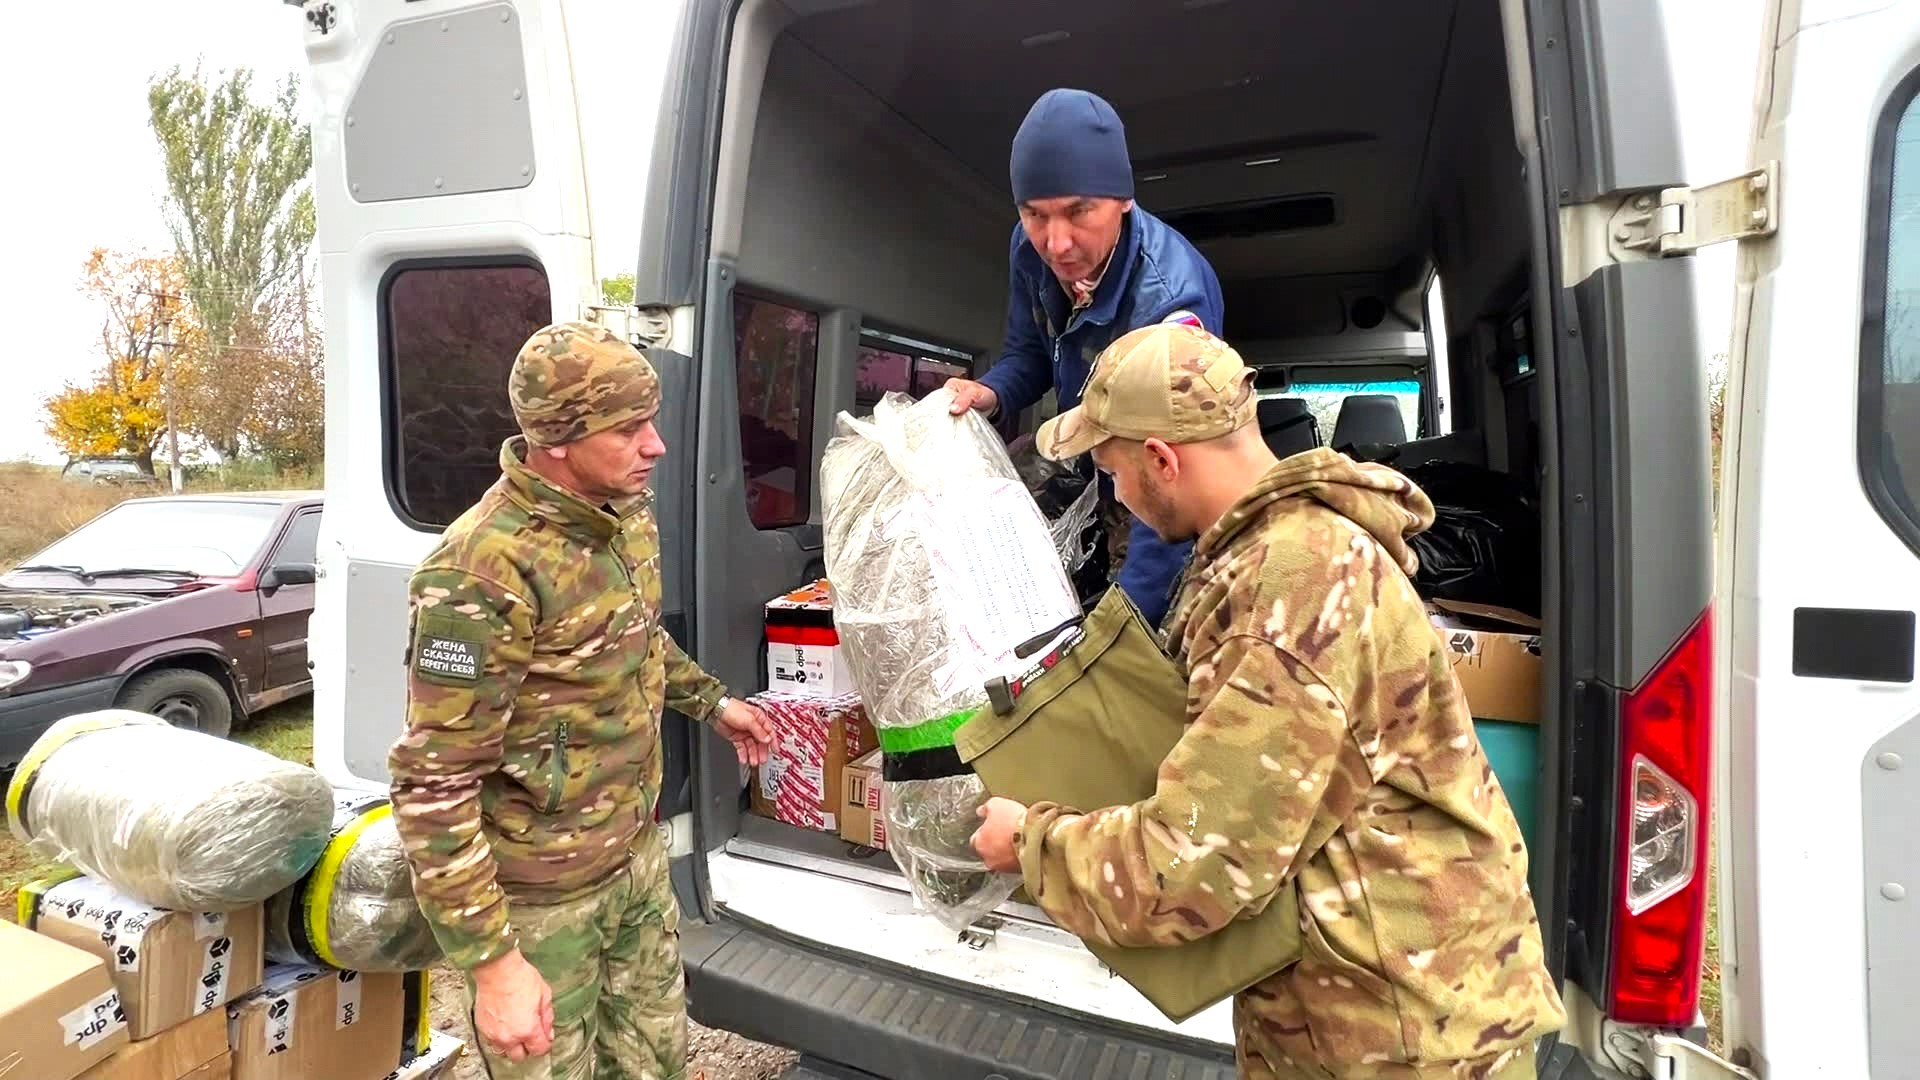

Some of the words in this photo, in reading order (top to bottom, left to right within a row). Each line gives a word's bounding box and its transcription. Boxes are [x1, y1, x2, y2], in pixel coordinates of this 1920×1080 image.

[431, 639, 466, 653] ЖЕНА
[423, 649, 475, 665] СКАЗАЛА
[451, 663, 475, 675] СЕБЯ
[341, 1002, 355, 1025] dpd
